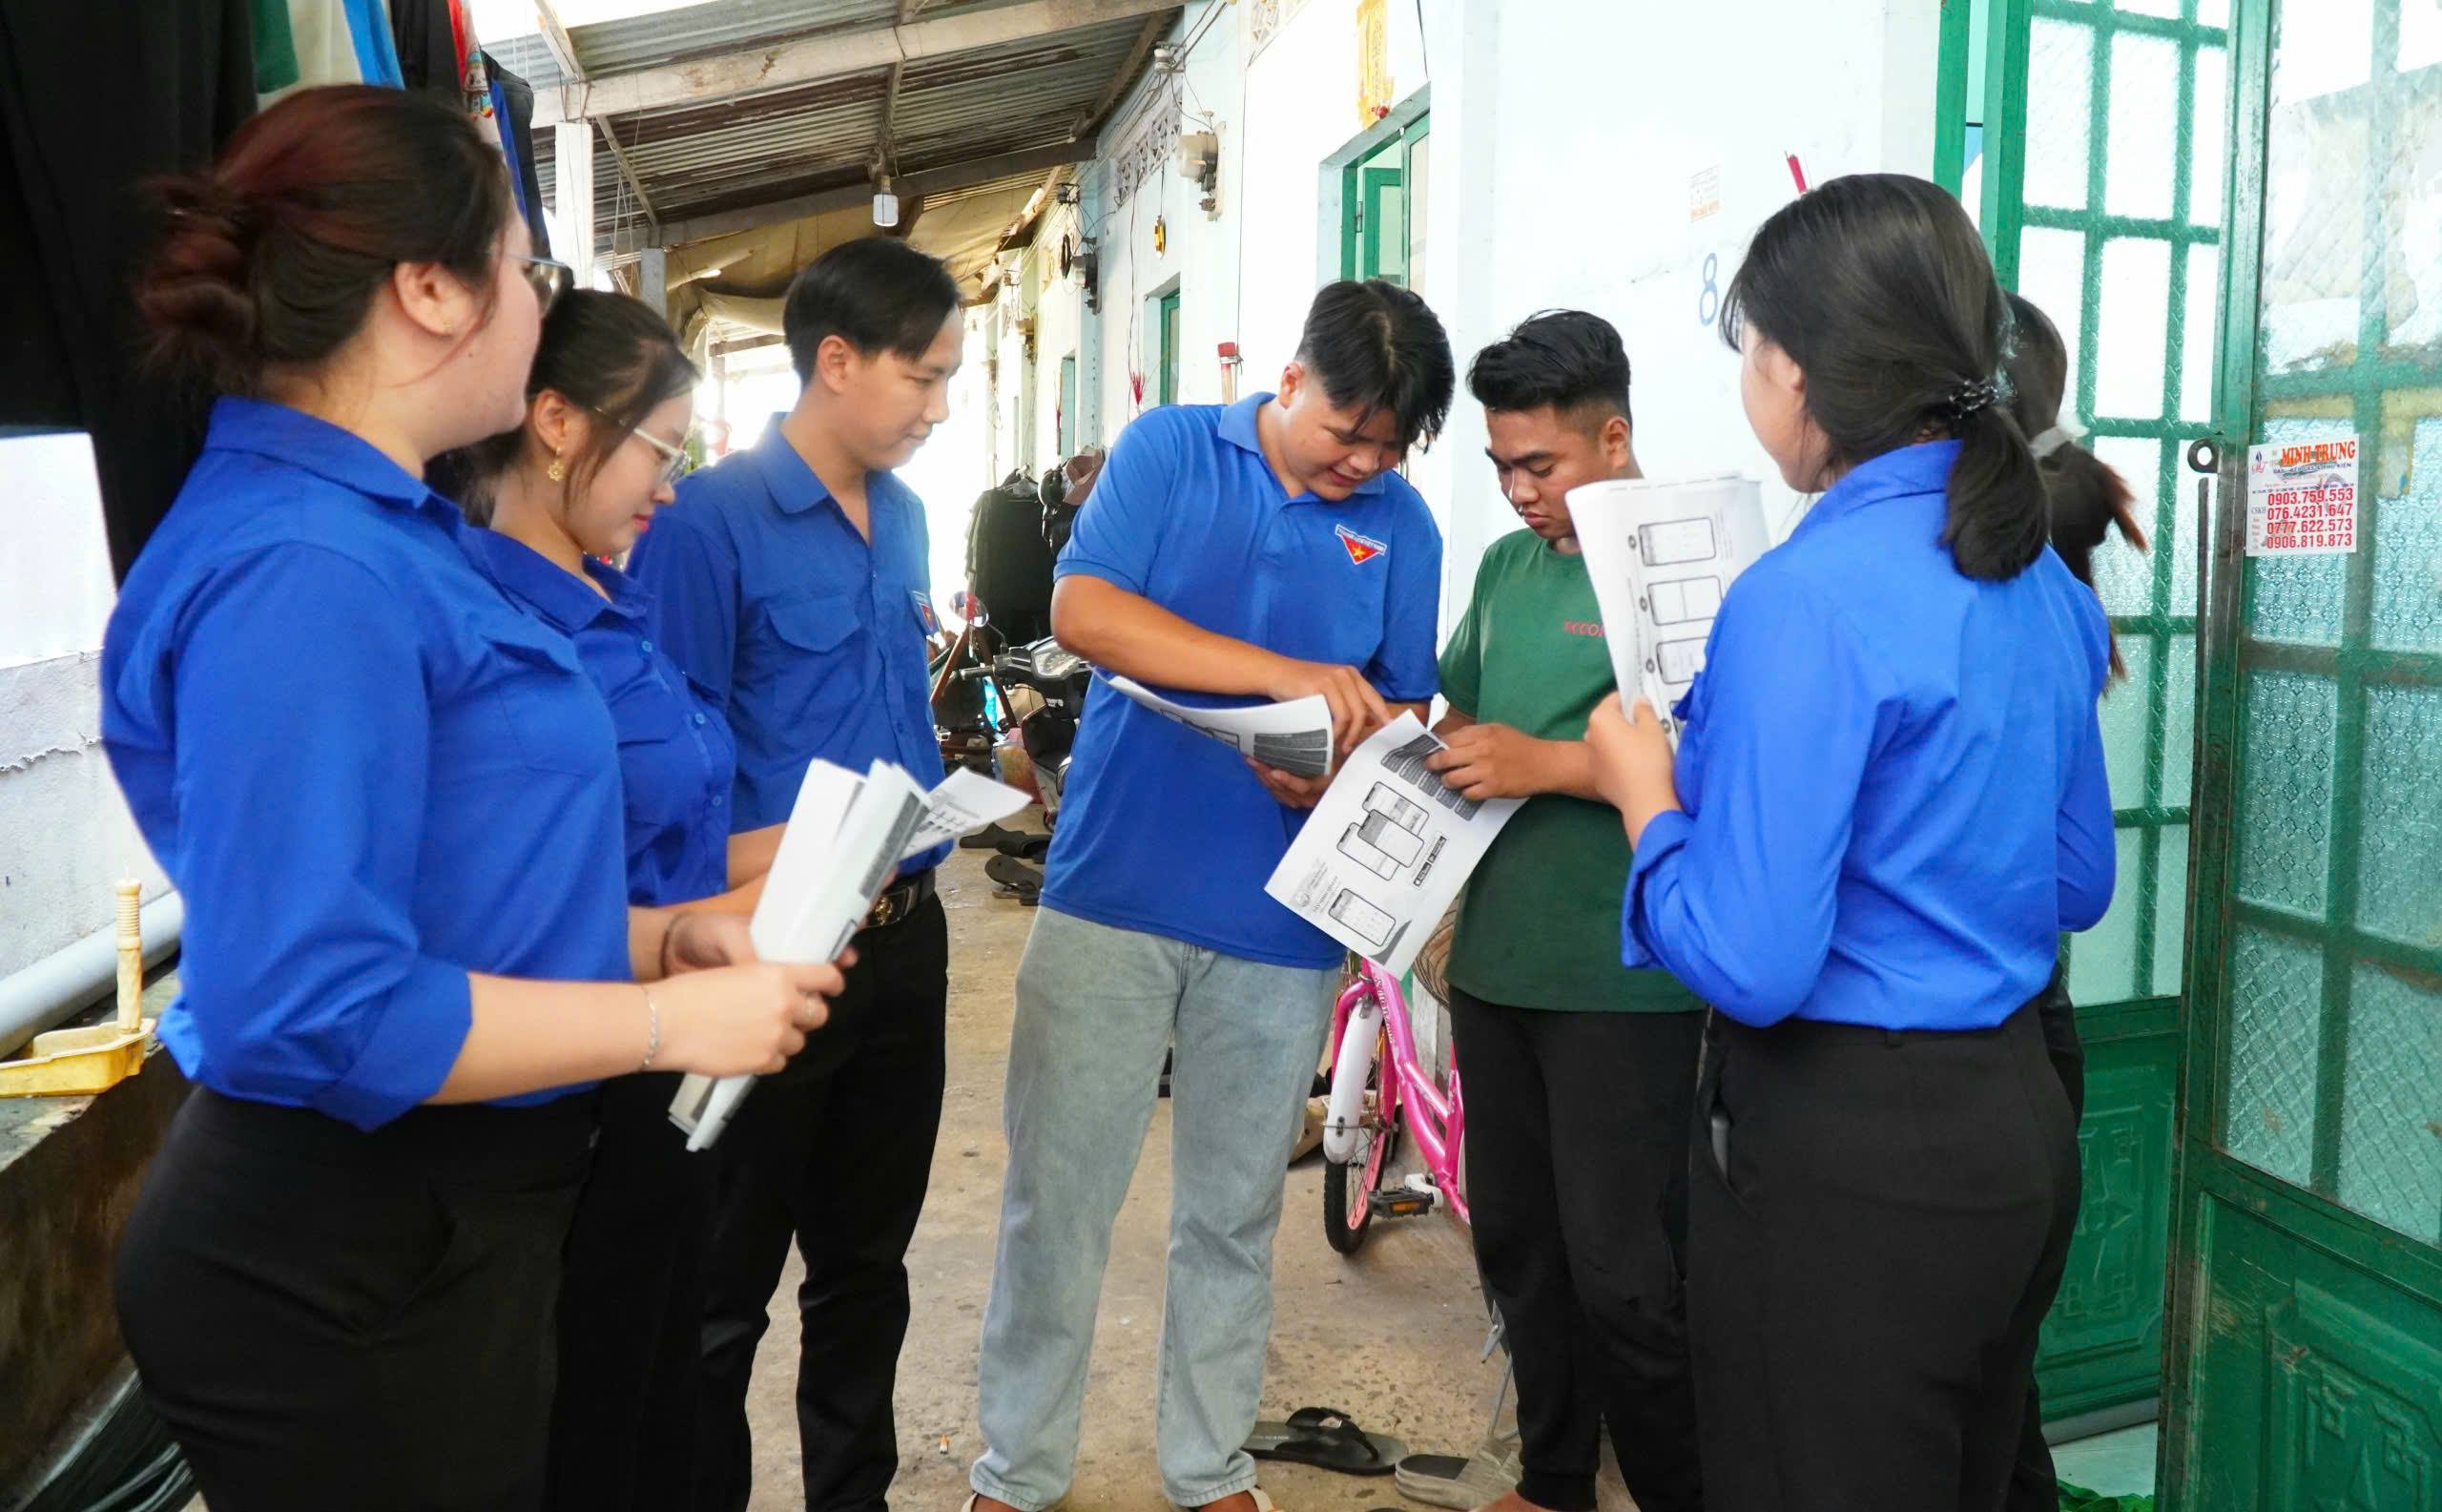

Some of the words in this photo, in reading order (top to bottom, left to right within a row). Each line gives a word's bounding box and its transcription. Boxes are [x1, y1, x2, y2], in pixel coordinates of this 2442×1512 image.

[1699, 252, 1719, 326] 8
[2280, 445, 2312, 466] MINH
[2315, 441, 2356, 463] TRUNG
[2267, 487, 2354, 507] 0903.759.553
[2267, 503, 2353, 521] 076.4231.647
[2266, 518, 2353, 535] 0777.622.573
[2266, 533, 2352, 549] 0906.819.873
